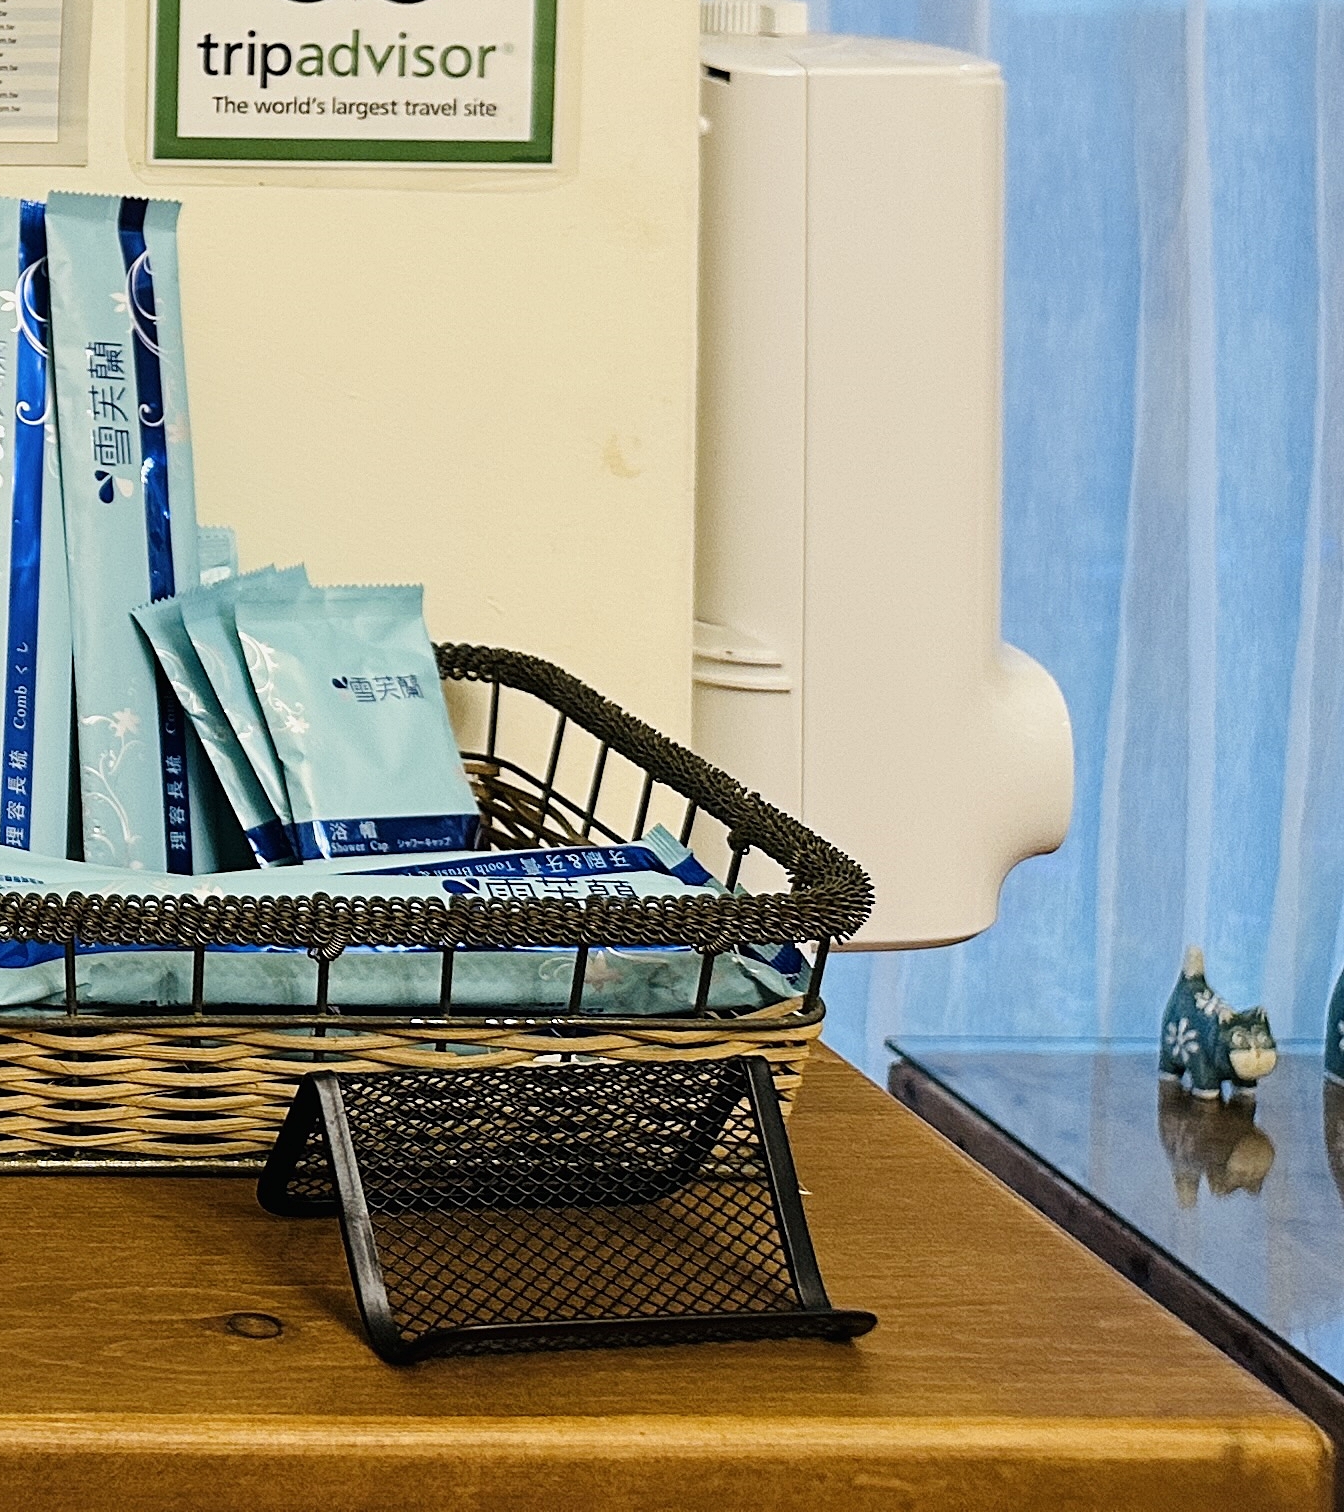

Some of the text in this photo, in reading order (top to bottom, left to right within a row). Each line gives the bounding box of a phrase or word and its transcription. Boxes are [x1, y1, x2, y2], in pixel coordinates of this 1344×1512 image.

[197, 29, 497, 89] tripadvisor
[213, 97, 497, 119] The world's largest travel site
[86, 341, 133, 466] 雪芙蘭
[13, 684, 29, 729] Comb
[5, 749, 29, 847] 理容長梳
[170, 754, 187, 851] 理容長梳
[330, 821, 378, 840] 浴帽
[331, 843, 365, 853] Shower
[370, 840, 388, 852] Cap
[475, 861, 516, 875] Tooth
